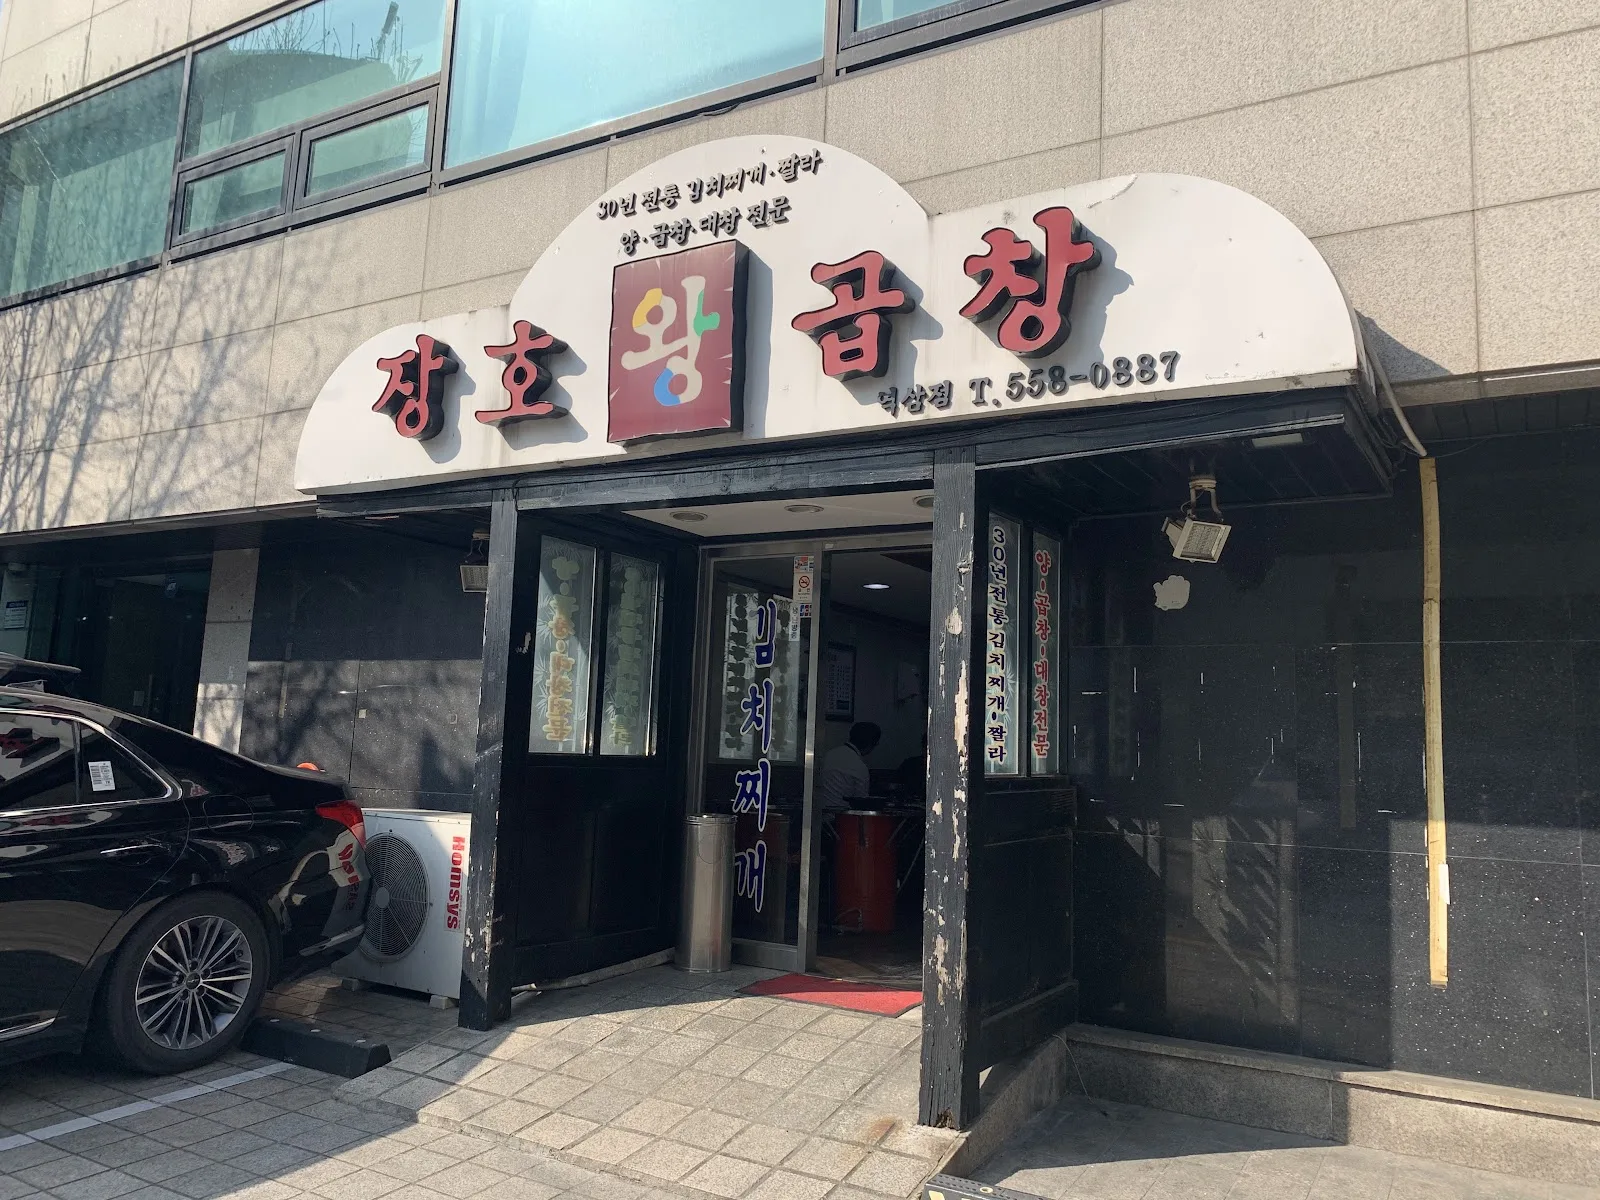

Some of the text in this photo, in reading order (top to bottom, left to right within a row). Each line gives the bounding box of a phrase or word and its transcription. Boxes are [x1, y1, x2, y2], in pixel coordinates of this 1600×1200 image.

[597, 192, 638, 220] 30년
[641, 183, 682, 211] 전통
[747, 195, 793, 228] 전문
[620, 274, 721, 407] 왕
[791, 205, 1097, 379] 곱창
[878, 379, 954, 418] 역삼점
[732, 598, 777, 913] 김치찌개
[446, 836, 466, 930] Homsys
